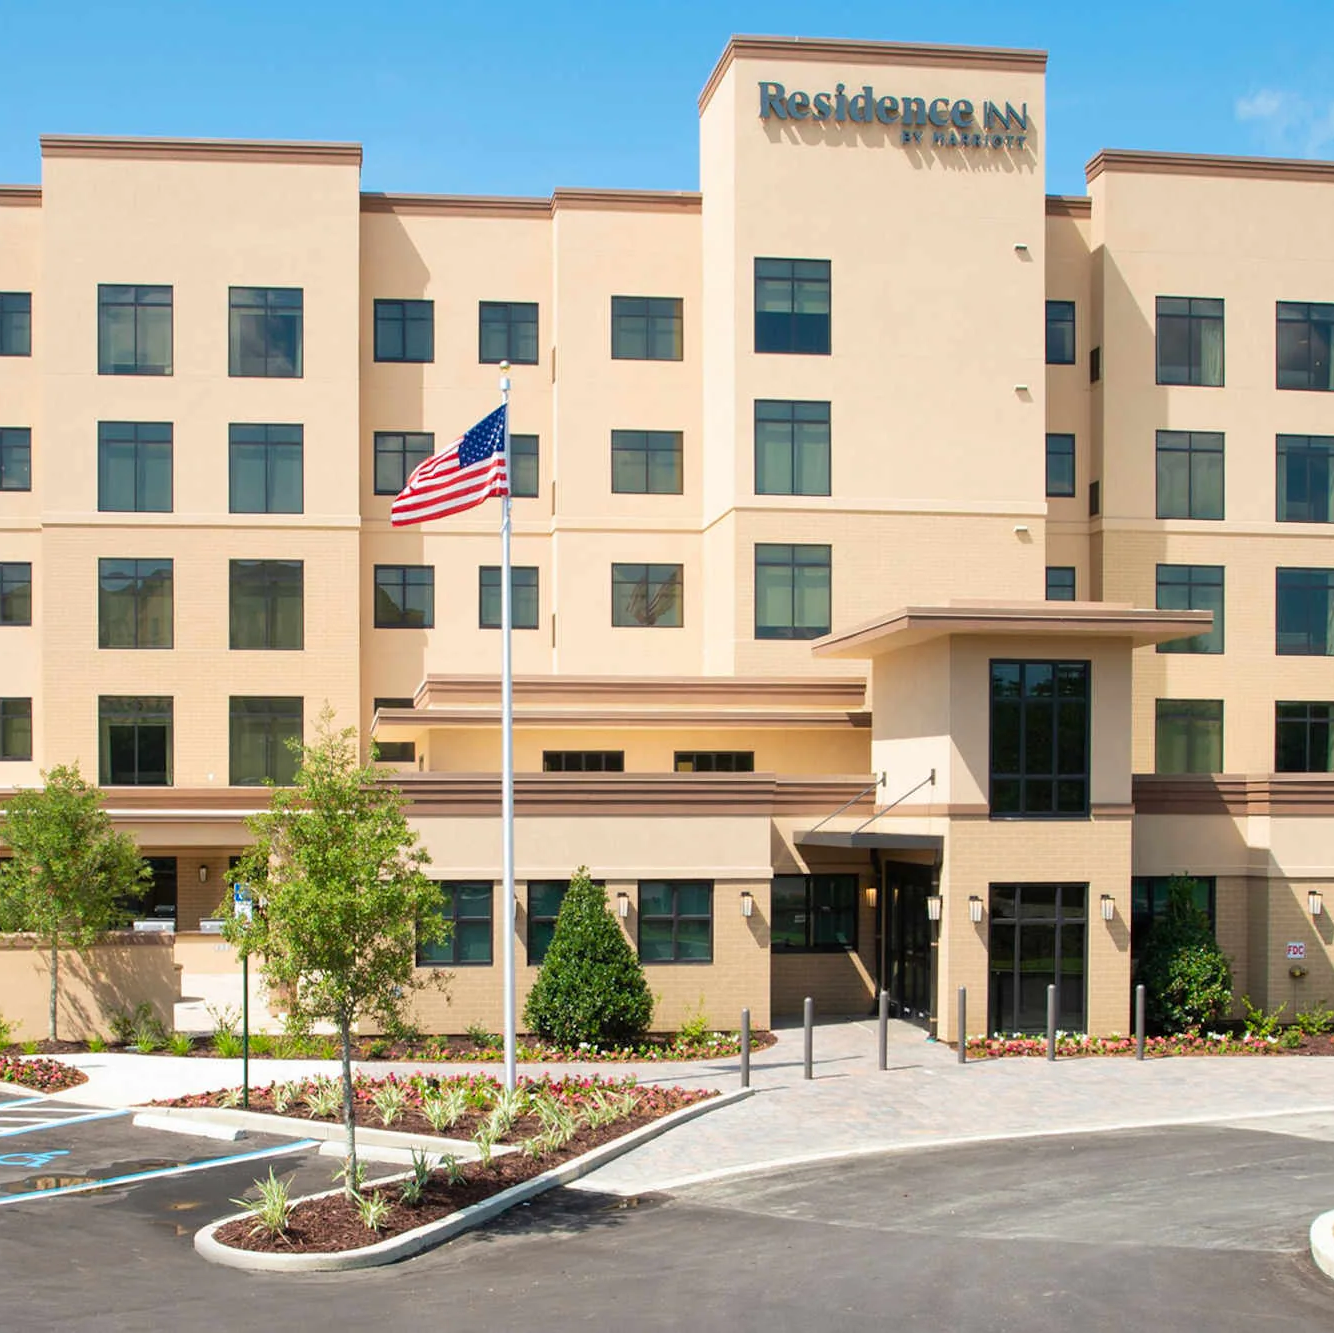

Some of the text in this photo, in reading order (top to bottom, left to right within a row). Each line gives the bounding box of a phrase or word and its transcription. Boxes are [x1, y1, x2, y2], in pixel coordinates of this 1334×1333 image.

[757, 81, 1027, 131] Residence INN
[901, 130, 1027, 150] BY MARRIOTT
[1287, 945, 1304, 955] FDC
